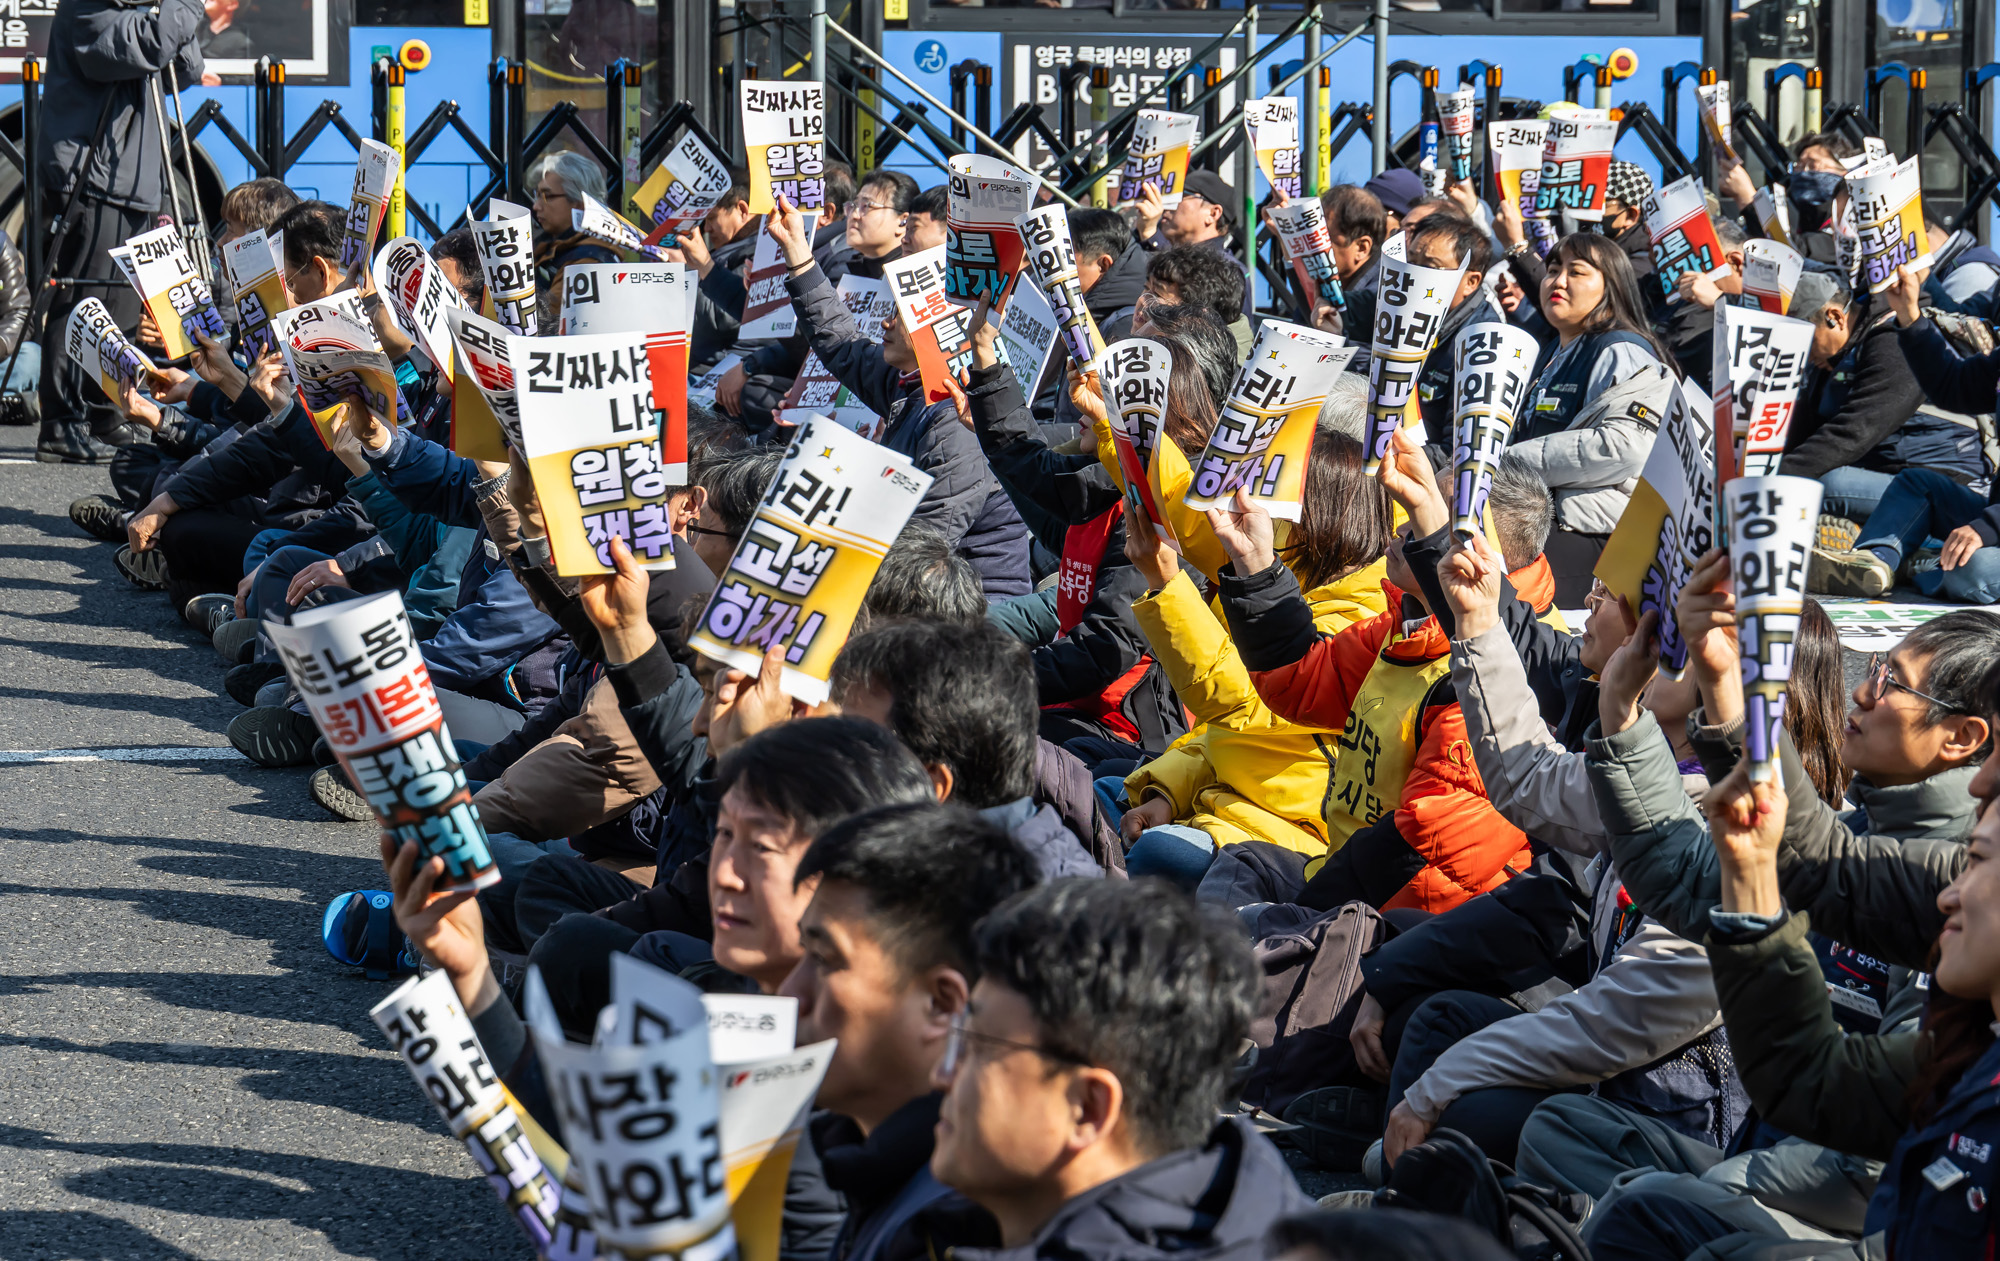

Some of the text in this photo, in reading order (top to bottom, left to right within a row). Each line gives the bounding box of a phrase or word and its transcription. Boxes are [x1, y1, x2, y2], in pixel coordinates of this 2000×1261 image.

[0, 19, 30, 48] 음
[1036, 46, 1073, 68] 영국
[1077, 45, 1151, 70] 클래식의
[766, 143, 824, 177] 원청
[1124, 153, 1164, 179] 교섭
[1541, 160, 1583, 184] 으로
[990, 183, 1022, 195] 민주노총
[1536, 184, 1596, 210] 하자!
[1866, 230, 1918, 284] 하자!
[630, 273, 675, 285] 민주노총
[896, 265, 935, 298] 모든
[945, 263, 1010, 306] 하자!
[910, 286, 955, 326] 노동
[527, 343, 653, 394] 진짜사
[1211, 405, 1288, 455] 교섭
[570, 440, 667, 508] 원청
[1195, 453, 1287, 499] 하자!
[730, 517, 837, 599] 교섭
[706, 580, 827, 666] 하자!
